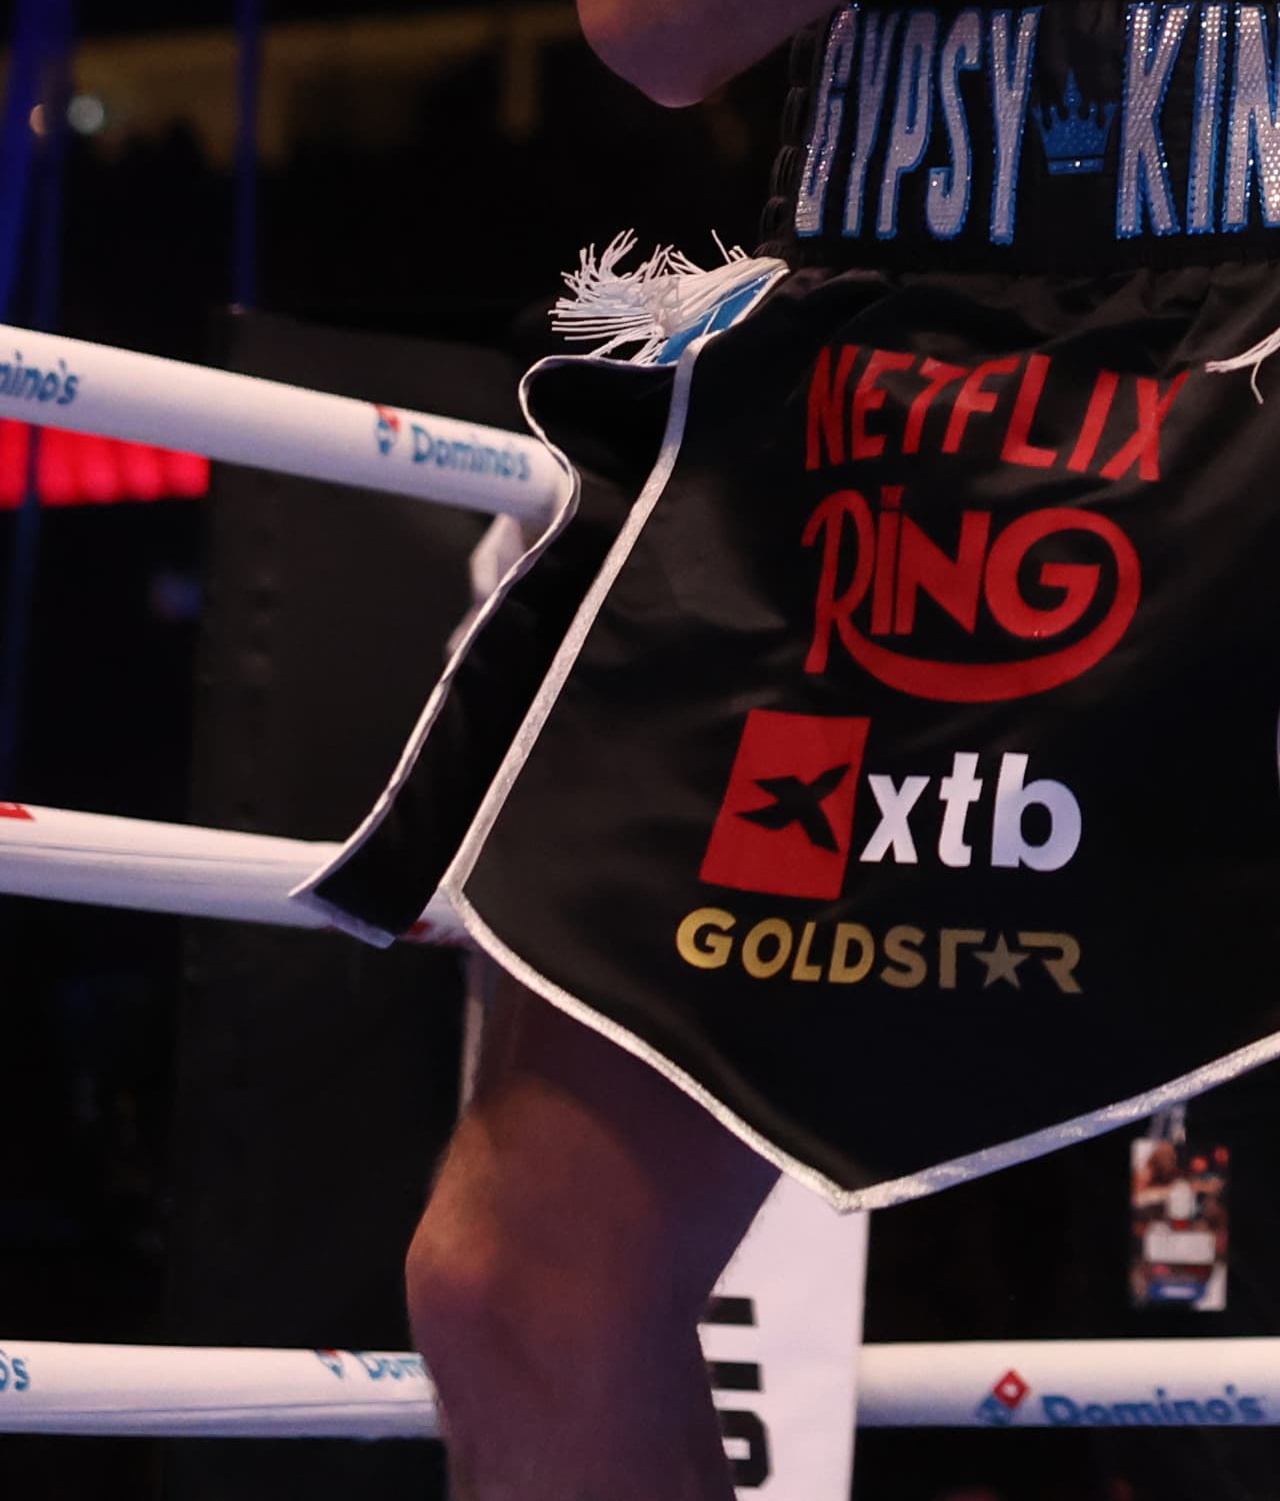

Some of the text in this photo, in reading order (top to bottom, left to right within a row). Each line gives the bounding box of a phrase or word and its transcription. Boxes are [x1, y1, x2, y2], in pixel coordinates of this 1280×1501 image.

[795, 1, 1042, 246] GYPSY
[410, 424, 532, 482] Domino's
[806, 344, 1189, 482] NETFLIX
[859, 751, 1083, 873] xtb
[1041, 1383, 1266, 1426] Domino's
